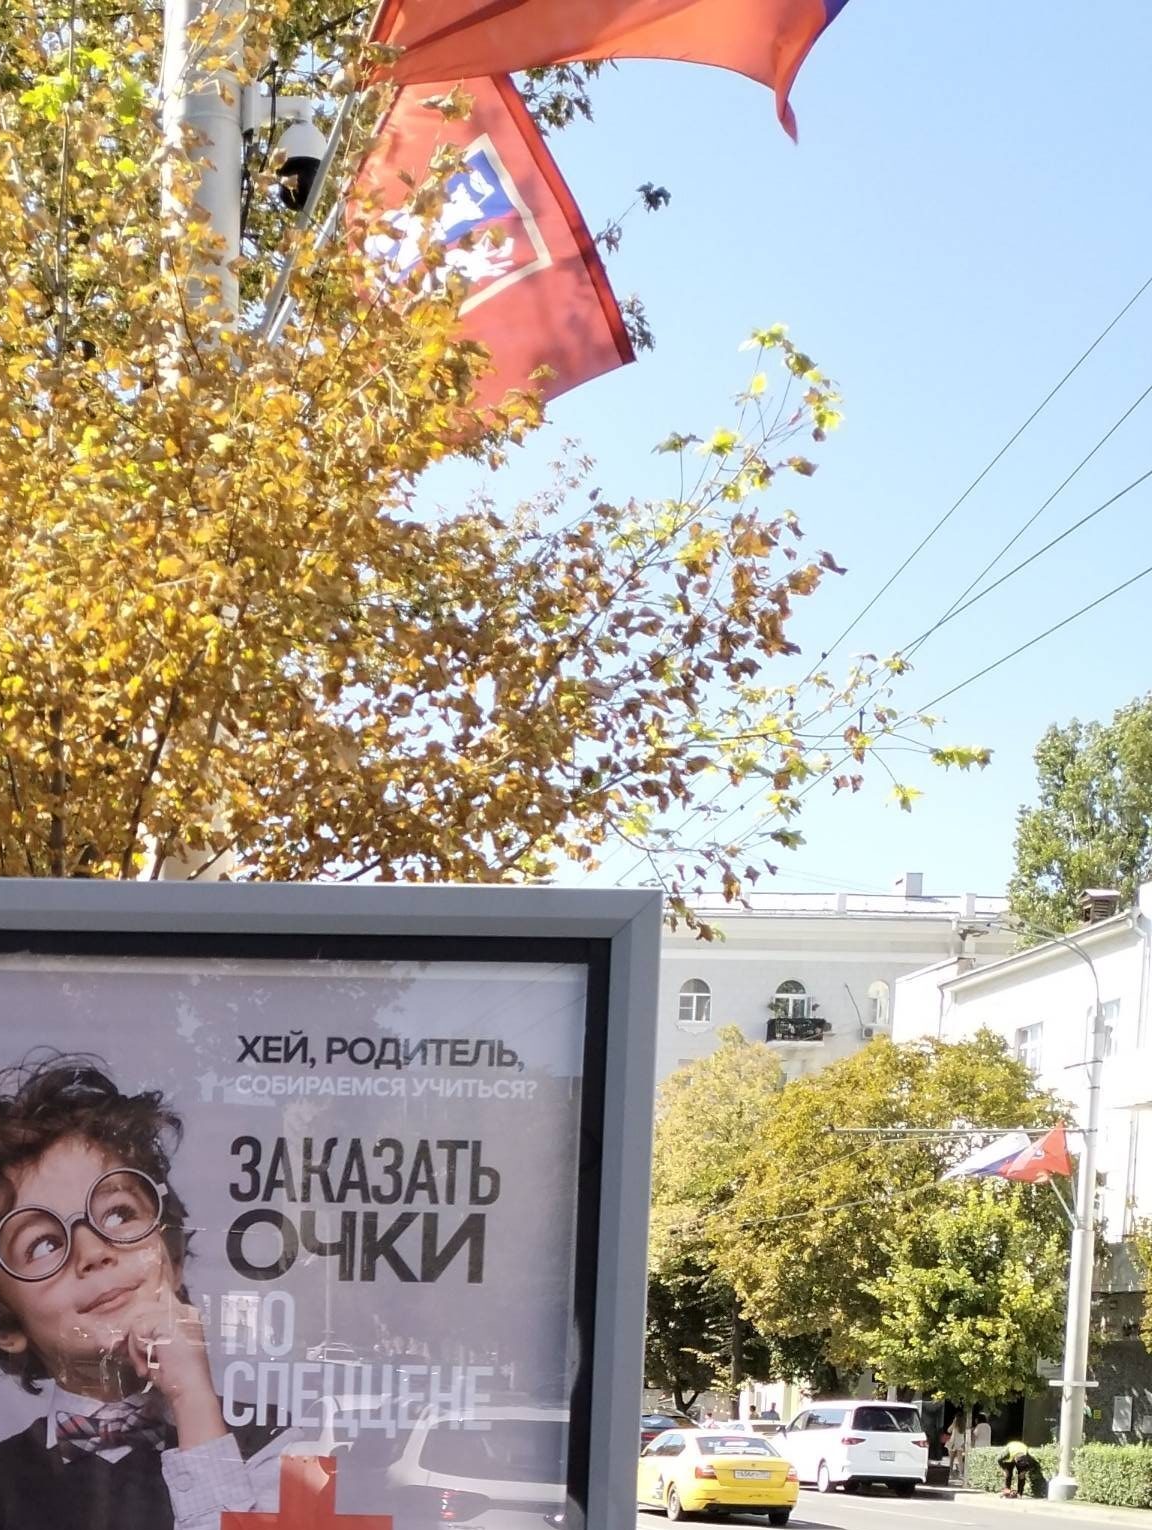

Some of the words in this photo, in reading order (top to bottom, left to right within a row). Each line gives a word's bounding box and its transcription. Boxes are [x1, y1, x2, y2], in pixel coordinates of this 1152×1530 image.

[236, 1030, 316, 1069] ХЕЙ,
[325, 1036, 526, 1072] РОДИТЕЛЬ,
[235, 1074, 406, 1098] СОБИРАЕМСЯ
[411, 1078, 537, 1100] УЧИТЬСЯ?
[229, 1135, 500, 1206] ЗАКАЗАТЬ
[225, 1208, 487, 1284] ОЧКИ
[223, 1289, 296, 1357] ПО
[222, 1360, 494, 1439] СПЕЦЦЕНЕ
